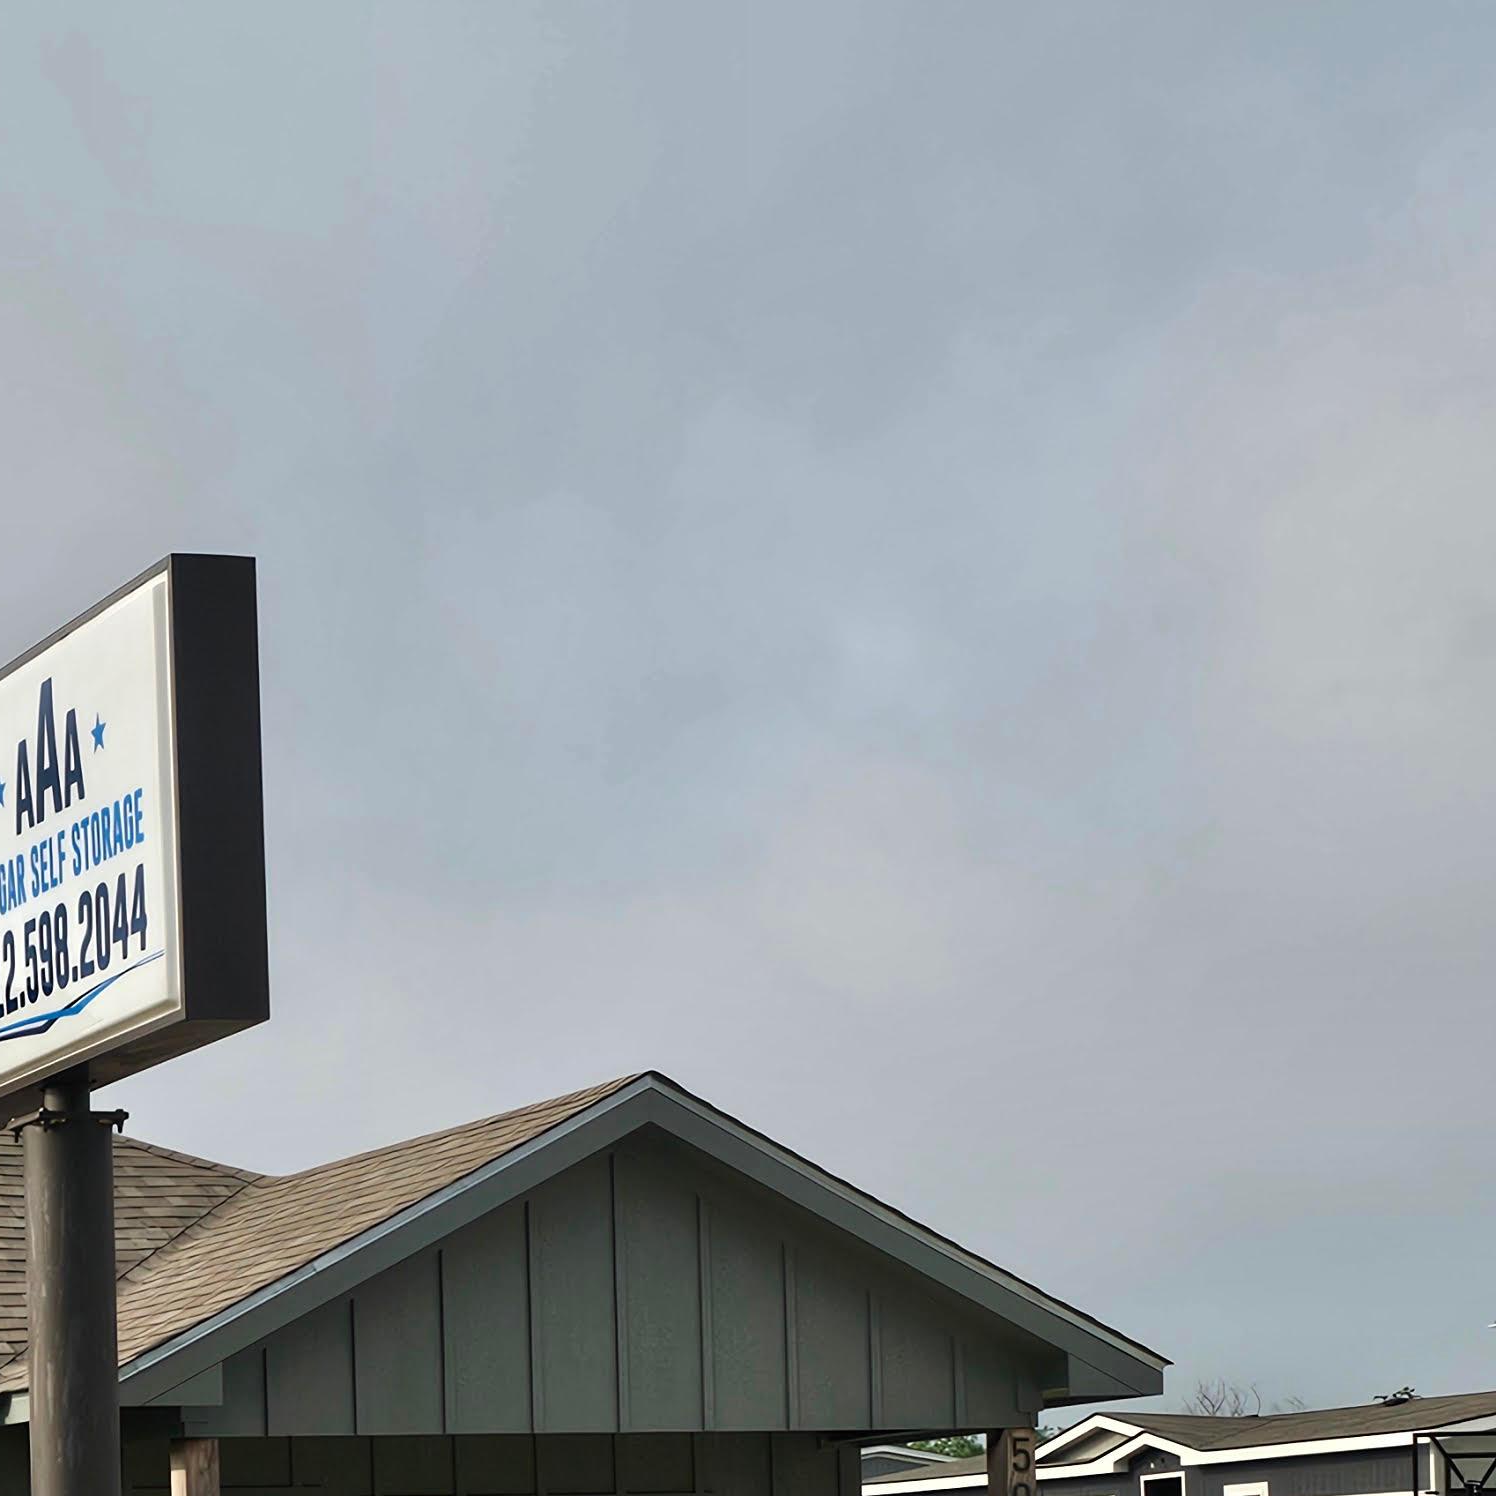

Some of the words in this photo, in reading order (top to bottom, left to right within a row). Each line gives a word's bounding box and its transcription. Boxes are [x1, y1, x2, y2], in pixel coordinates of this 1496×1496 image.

[15, 677, 86, 834] AAA
[31, 830, 66, 897] SELF
[71, 788, 144, 876] STORAGE
